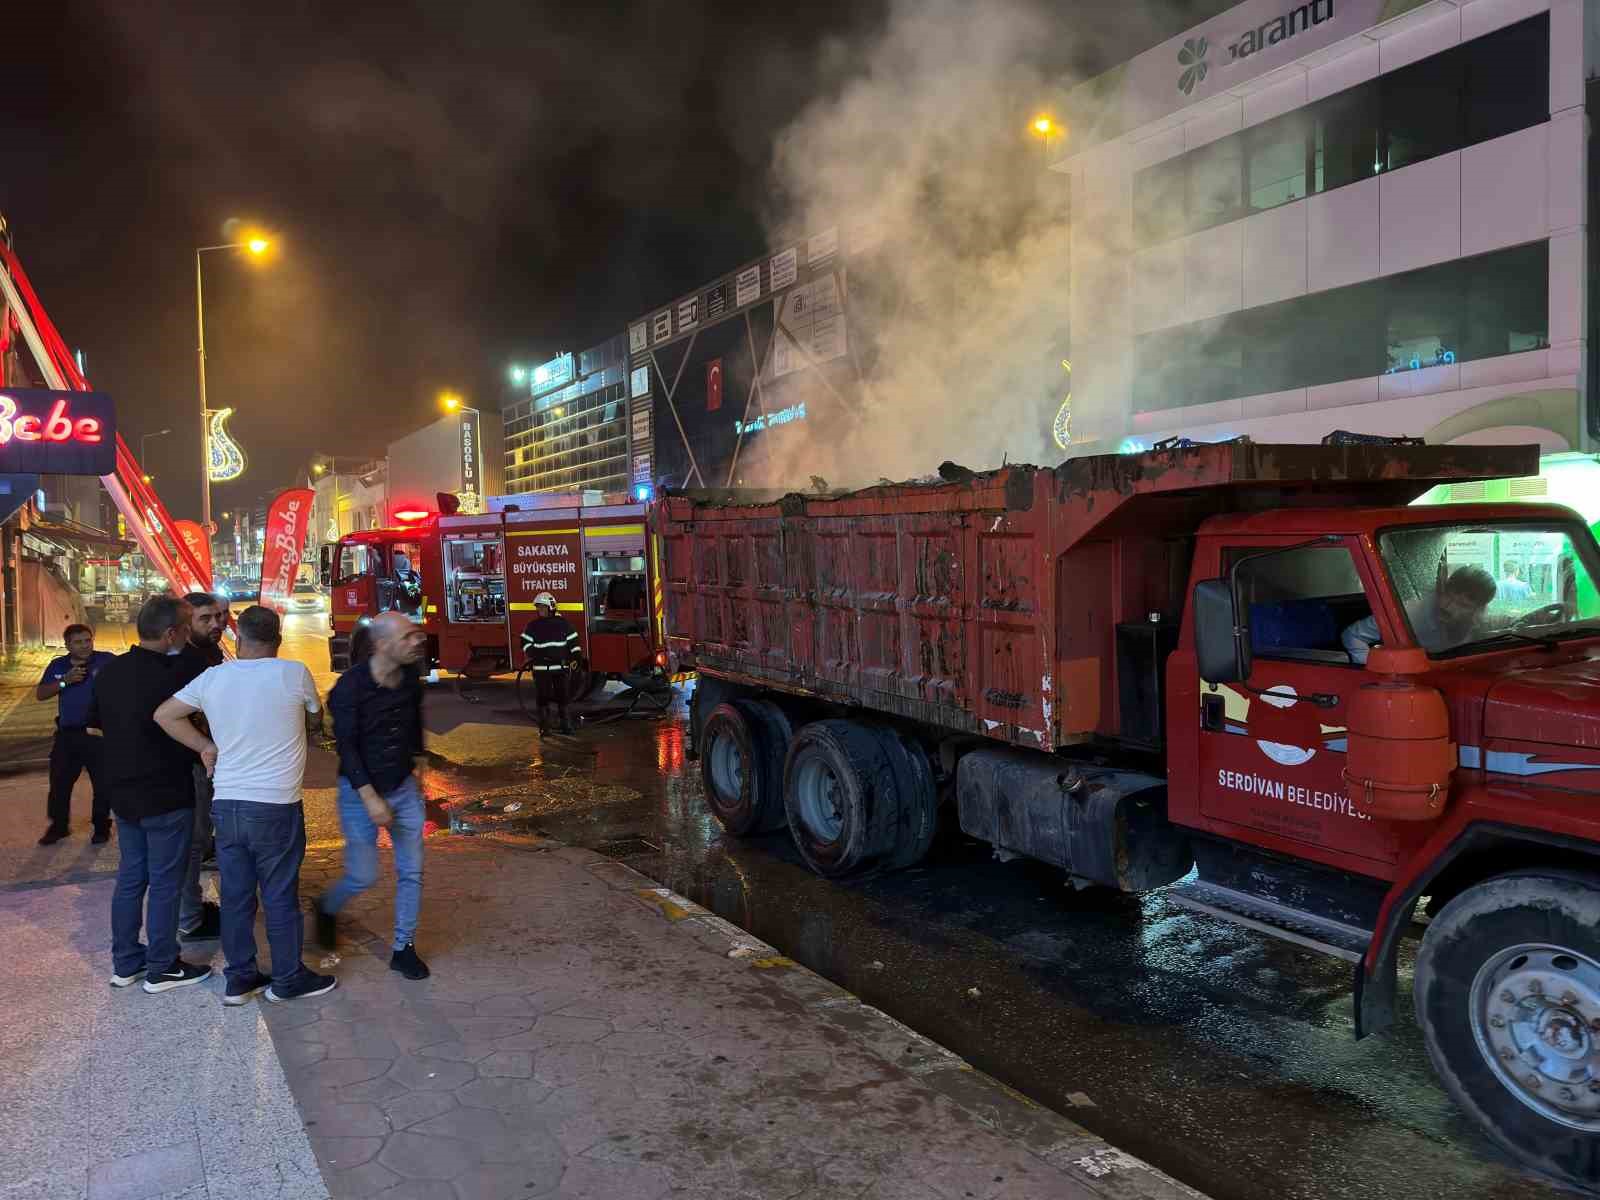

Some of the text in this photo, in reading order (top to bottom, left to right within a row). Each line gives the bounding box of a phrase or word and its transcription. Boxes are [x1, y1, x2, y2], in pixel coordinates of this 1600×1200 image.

[1222, 0, 1334, 61] aranti
[517, 544, 569, 557] SAKARYA
[513, 561, 576, 575] BÜYÜKŞEHİR
[522, 577, 568, 591] İTFAİYESİ
[1218, 768, 1372, 821] SERDİVAN BELEDİYE
